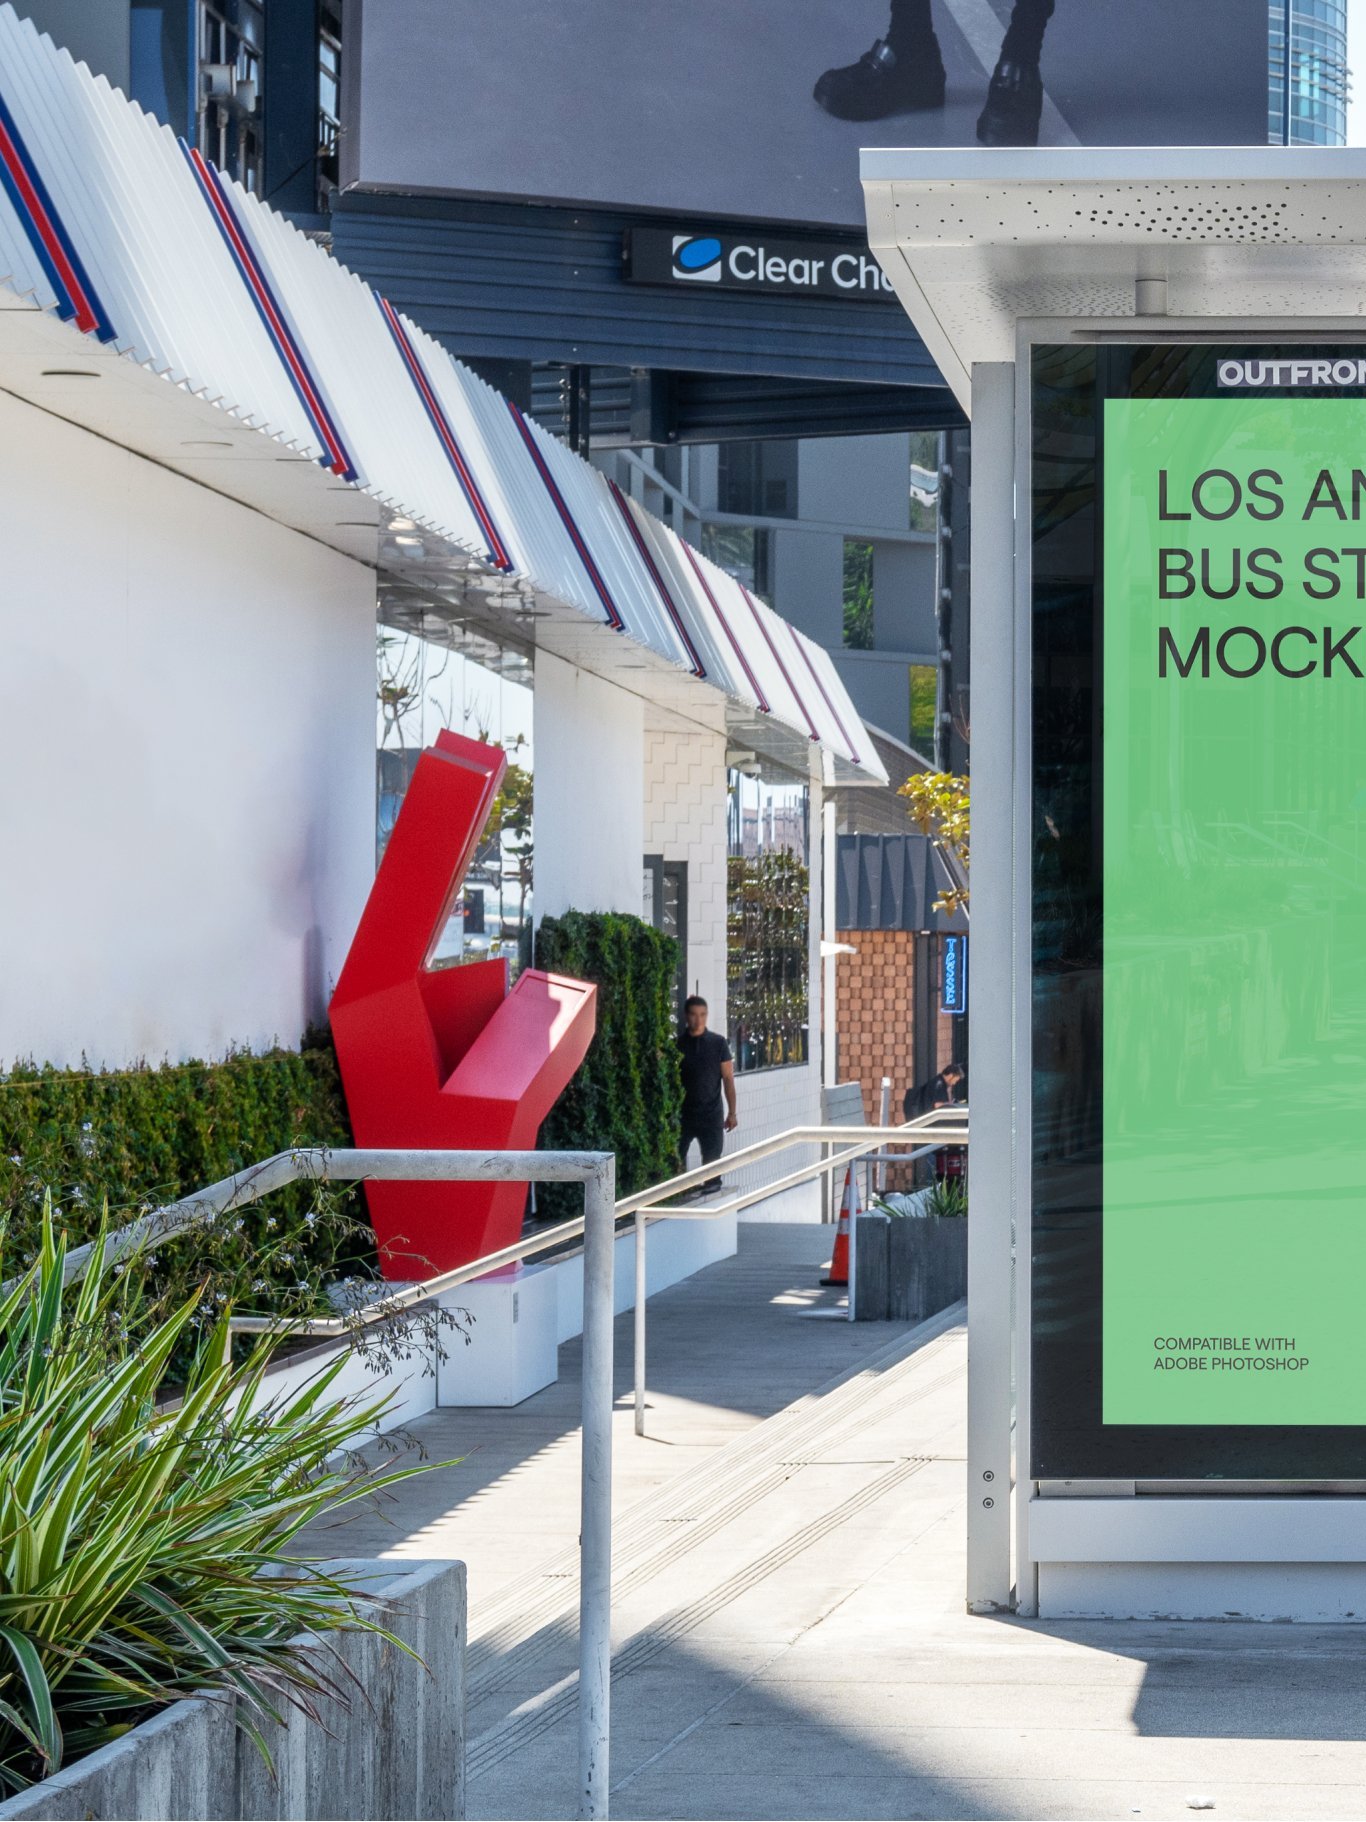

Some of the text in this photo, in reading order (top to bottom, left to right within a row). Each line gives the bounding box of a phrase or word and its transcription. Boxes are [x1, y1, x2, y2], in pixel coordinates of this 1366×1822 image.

[729, 246, 824, 285] Clear
[1158, 469, 1285, 521] LOS
[1158, 548, 1285, 600] BUS
[1153, 1337, 1296, 1351] COMPATIBLE WITH
[1153, 1357, 1309, 1371] ADOBE PHOTOSHOP
